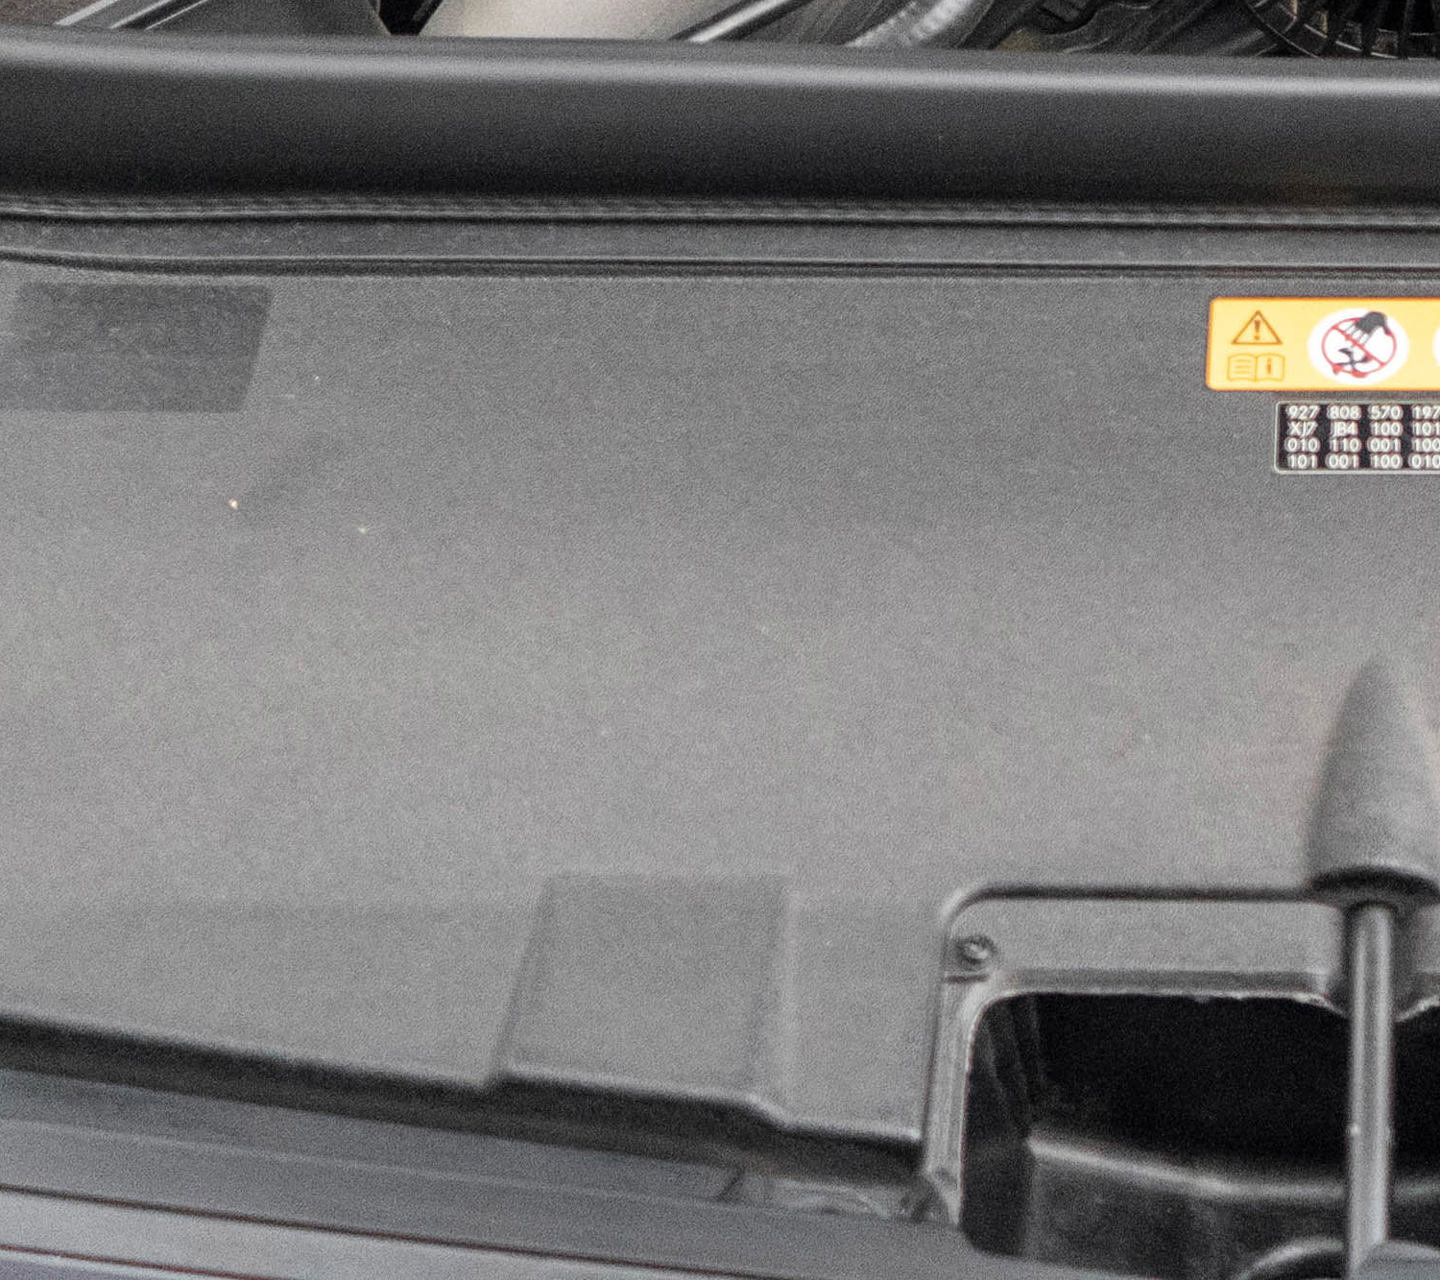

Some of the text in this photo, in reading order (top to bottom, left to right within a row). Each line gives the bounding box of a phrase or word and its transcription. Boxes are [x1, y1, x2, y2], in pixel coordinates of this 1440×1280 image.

[1289, 405, 1319, 419] 927
[1330, 405, 1360, 419] 808
[1370, 405, 1401, 419] 570
[1289, 421, 1317, 437] XJ7
[1331, 421, 1356, 437] JB4
[1373, 421, 1401, 436] 100
[1414, 421, 1440, 436] 101
[1287, 437, 1319, 452] 010
[1332, 437, 1360, 452] 110
[1370, 437, 1399, 452] 001
[1290, 454, 1315, 468] 101
[1328, 454, 1358, 468] 001
[1373, 454, 1401, 468] 100
